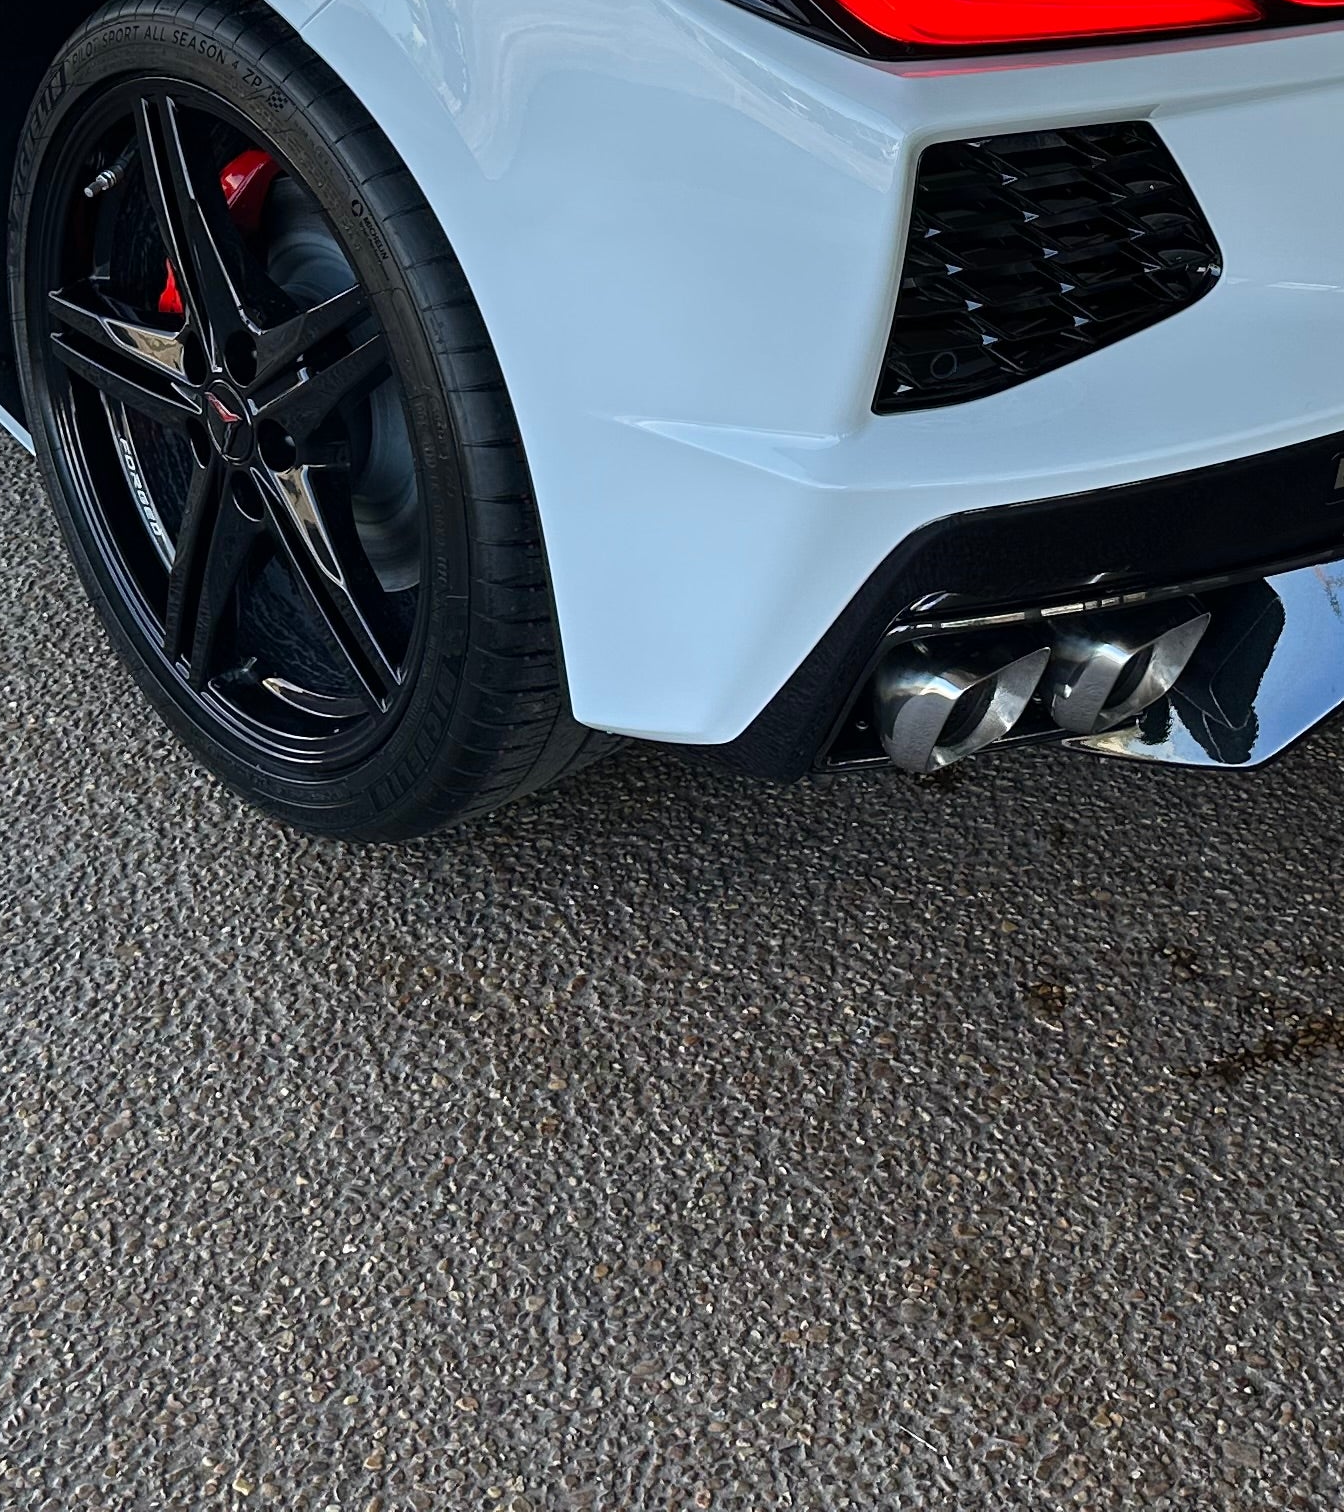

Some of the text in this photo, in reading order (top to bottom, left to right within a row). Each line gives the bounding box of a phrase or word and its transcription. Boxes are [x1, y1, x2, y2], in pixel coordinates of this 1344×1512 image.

[72, 38, 98, 65] PILOT
[102, 25, 140, 48] SPORT
[144, 25, 166, 42] ALL
[172, 29, 226, 65] SEASON
[242, 68, 262, 87] ZP
[362, 216, 389, 260] MICHELIN
[119, 437, 163, 537] FORGED
